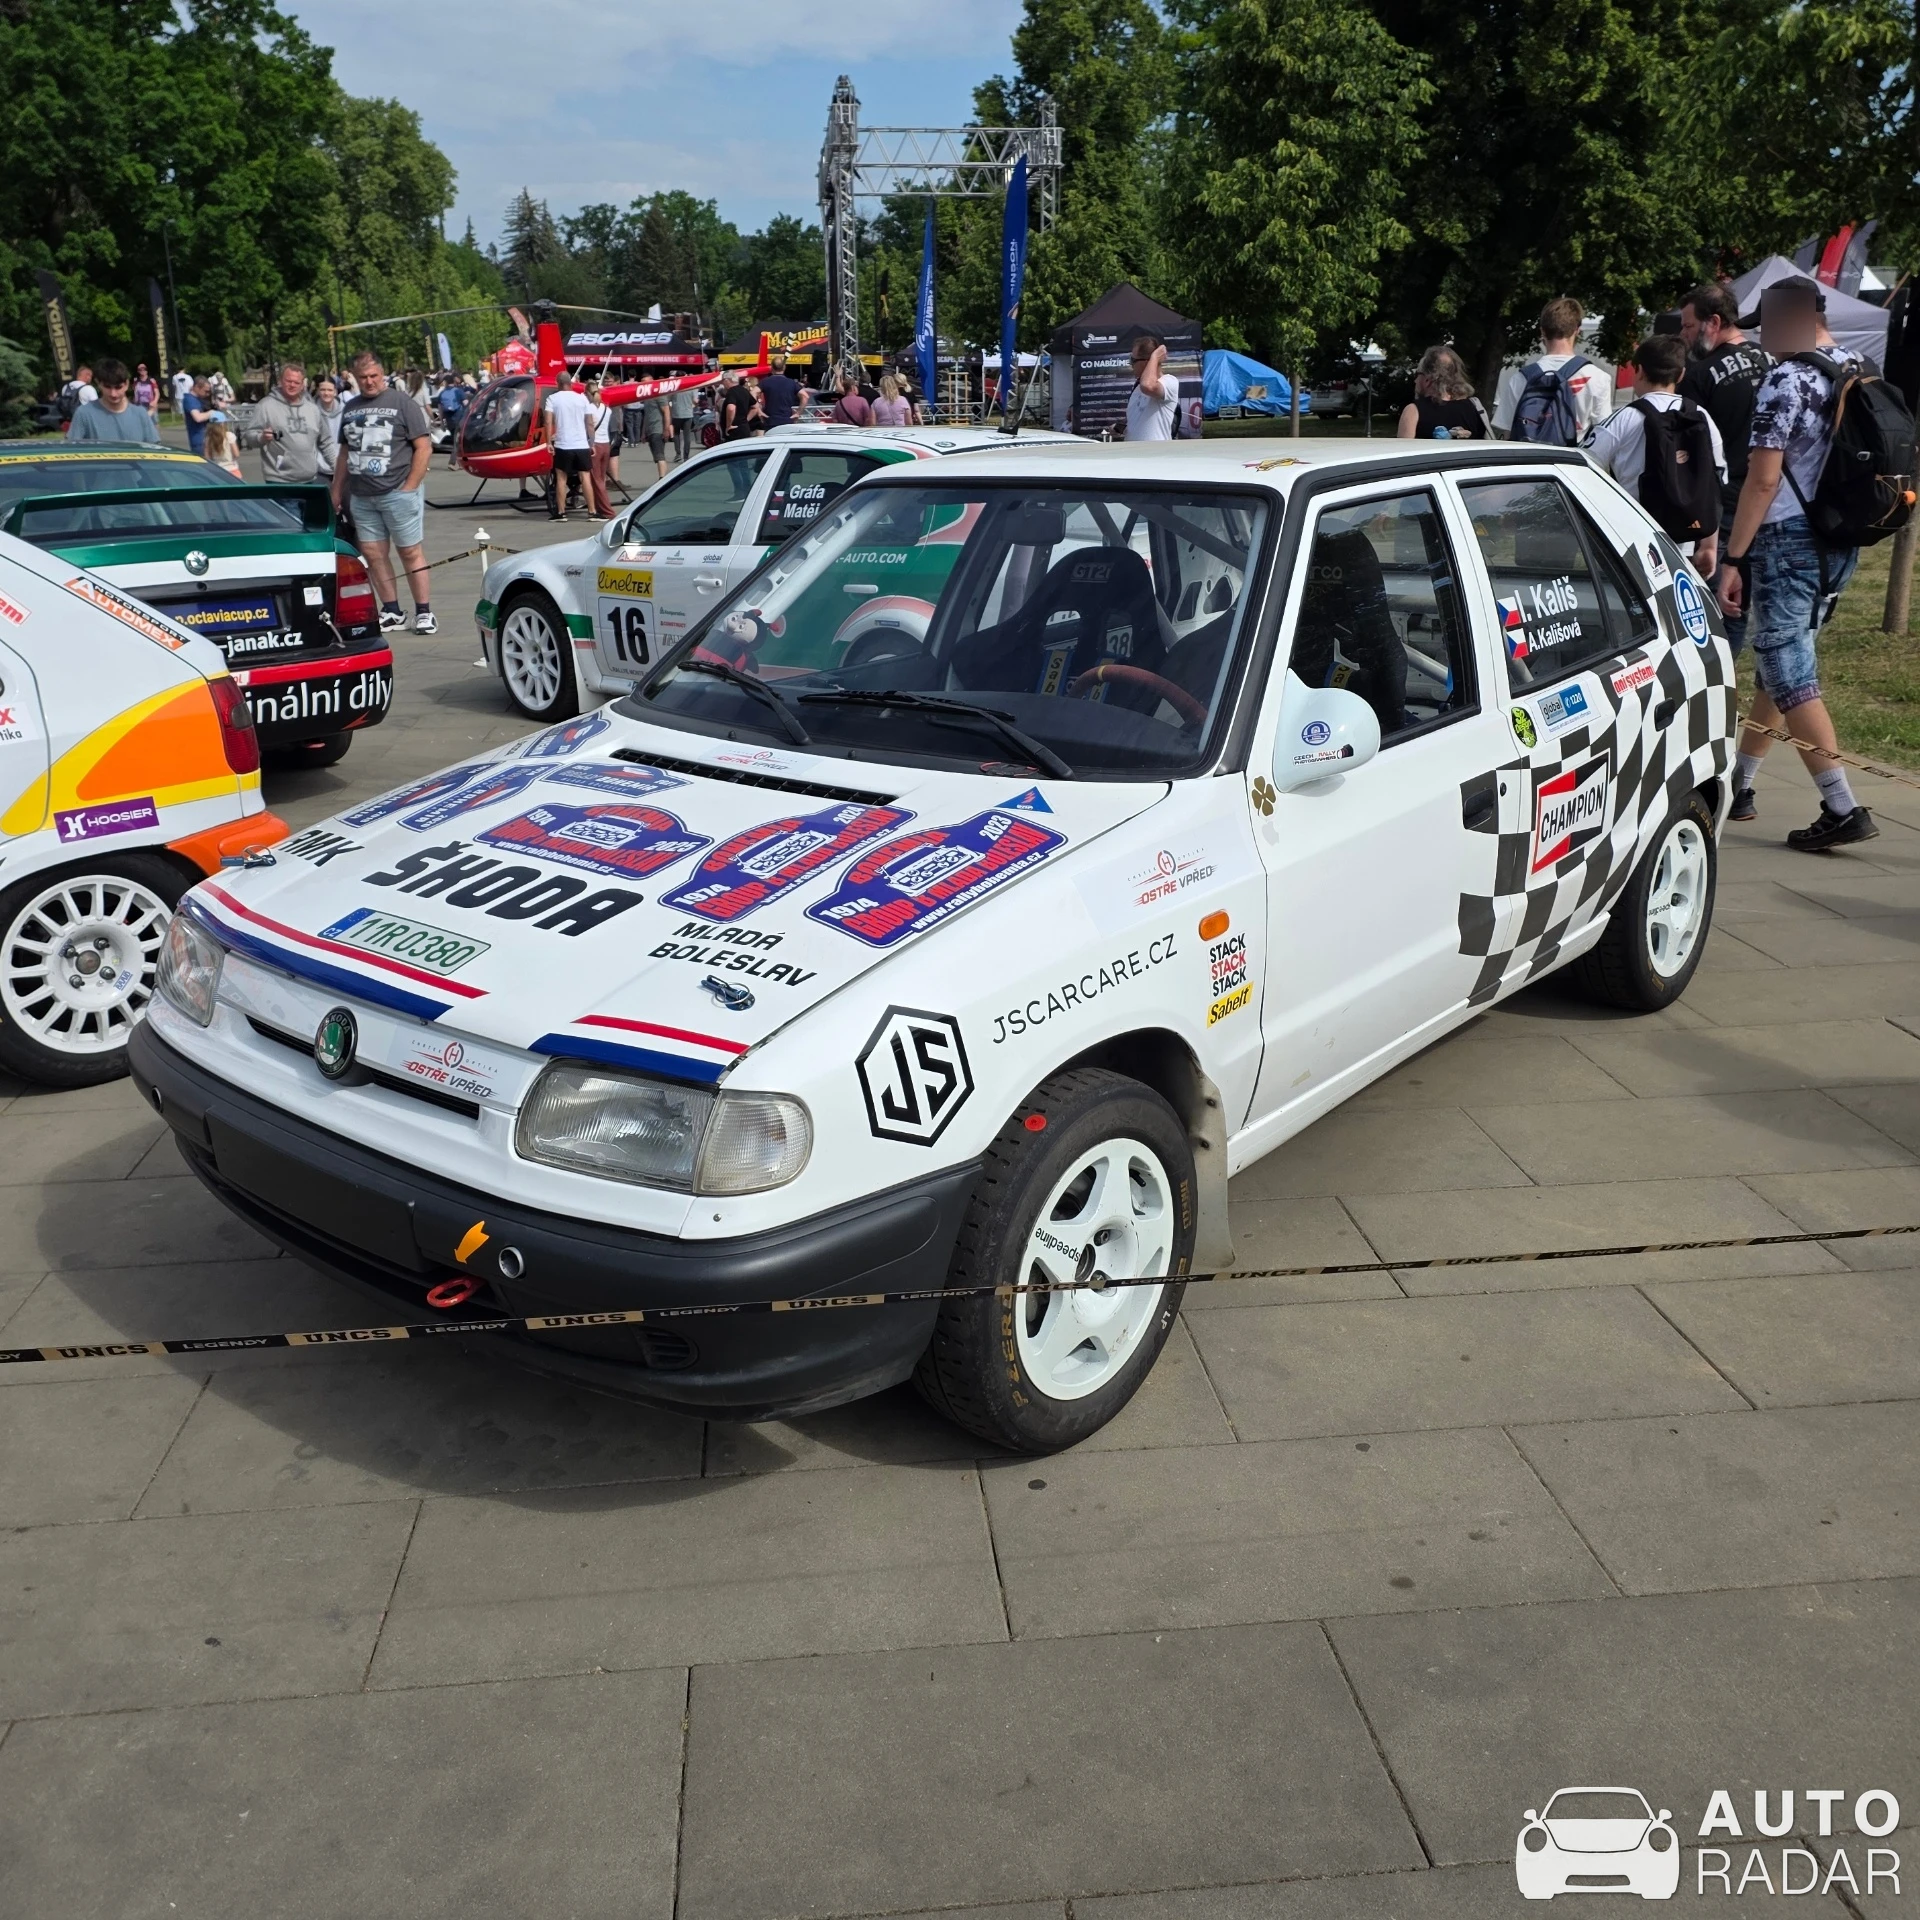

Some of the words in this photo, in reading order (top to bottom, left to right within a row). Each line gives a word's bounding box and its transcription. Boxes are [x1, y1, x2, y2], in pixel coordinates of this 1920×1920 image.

[567, 332, 673, 346] ESCAPE6
[1081, 361, 1092, 369] CO
[1094, 358, 1130, 368] NABÍZÍME
[789, 484, 826, 500] Gráfa
[702, 553, 724, 565] global
[74, 579, 176, 650] AUTOMEX
[1529, 575, 1578, 619] Kališ
[607, 606, 650, 665] 16
[1528, 616, 1582, 653] A.Kališová
[350, 669, 393, 712] díly
[1543, 698, 1563, 720] global
[1569, 692, 1583, 706] 1220
[86, 806, 154, 828] HOOSIER
[526, 808, 557, 826] 1974
[832, 805, 867, 825] 2024
[979, 814, 1013, 842] 2023
[1541, 781, 1606, 843] CHAMPION
[494, 840, 616, 875] www.rallybohemia.cz
[644, 840, 700, 852] 2025
[693, 880, 770, 919] GROUP
[828, 808, 902, 850] BOLESLAV
[702, 818, 805, 873] BOHEMIA
[847, 831, 952, 885] BOHEMIA
[360, 840, 645, 937] ŠKODA
[671, 883, 732, 906] 1974
[840, 897, 922, 940] GROUP
[976, 821, 1052, 872] BOLESLAV
[910, 850, 1046, 931] www.rallybohemia.cz
[1140, 880, 1178, 905] OSTŘE
[1178, 864, 1214, 888] VPŘED
[818, 897, 882, 920] 1974
[321, 925, 340, 938] CZ
[671, 921, 786, 951] MLADÁ
[1210, 932, 1247, 964] STACK
[647, 942, 818, 987] BOLESLAV
[1211, 949, 1247, 980] STACK
[1212, 965, 1247, 997] STACK
[992, 933, 1178, 1044] JSCARCARE.CZ
[1210, 986, 1250, 1025] Sabelt
[407, 1061, 450, 1083] OSTŘE
[449, 1075, 492, 1098] VPŘED
[881, 1024, 958, 1126] JS
[1035, 1227, 1081, 1263] speedline
[59, 1344, 149, 1359] UNCS
[182, 1338, 268, 1351] LEGENDY
[302, 1328, 391, 1343] UNCS
[425, 1320, 509, 1333] LEGENDY
[542, 1312, 628, 1327] UNCS
[659, 1305, 741, 1317] LEGENDY
[787, 1295, 869, 1309] UNCS
[900, 1288, 979, 1300] LEGENDY
[1012, 1281, 1091, 1294] UNCS
[1120, 1274, 1199, 1286] LEGENDY
[1230, 1268, 1308, 1279] UNCS
[1337, 1261, 1415, 1271] LEGENDY
[1447, 1254, 1524, 1265] UNCS
[1553, 1247, 1633, 1258] LEGENDY
[1660, 1240, 1734, 1251] UNCS
[1764, 1232, 1842, 1243] LEGENDY
